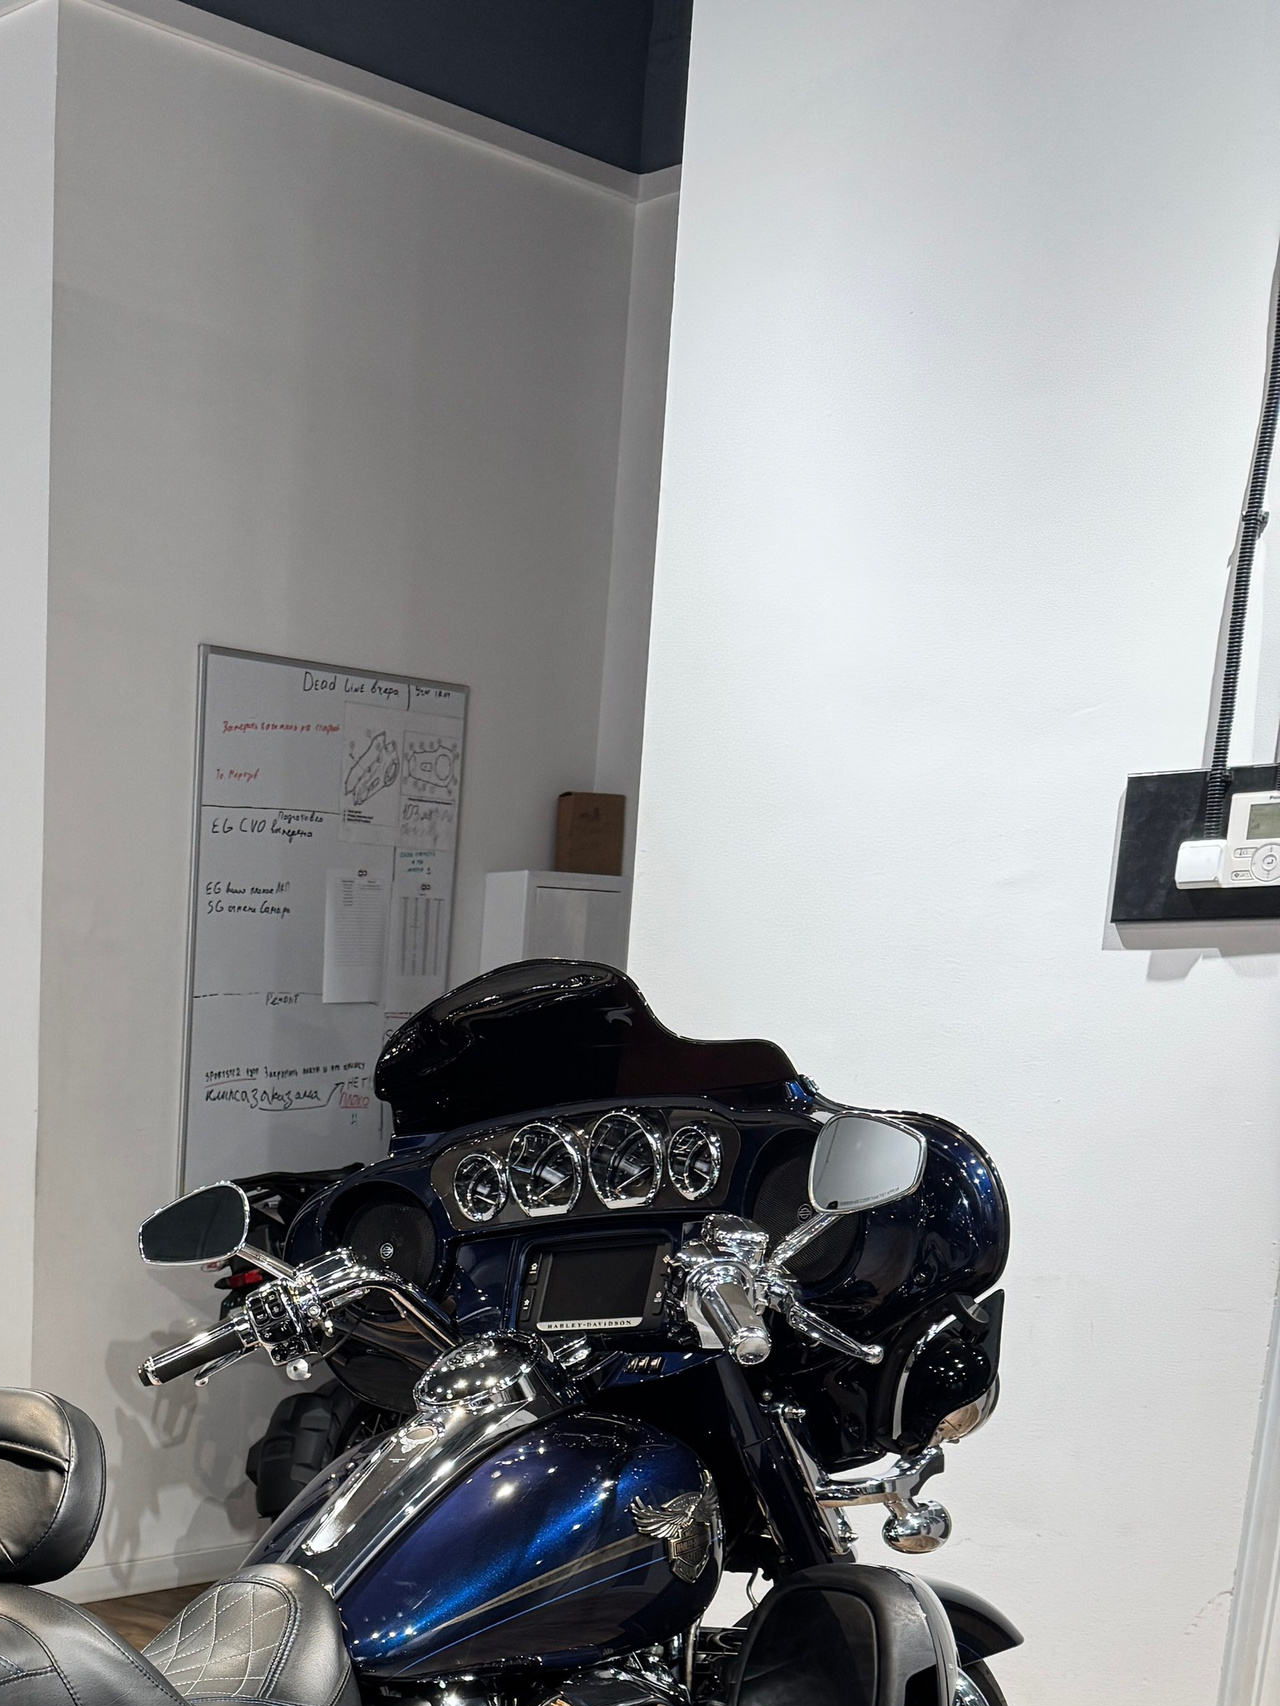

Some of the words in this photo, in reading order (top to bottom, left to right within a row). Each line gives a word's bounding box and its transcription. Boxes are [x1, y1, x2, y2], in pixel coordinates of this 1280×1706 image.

[239, 817, 266, 833] CVO
[205, 881, 221, 895] EG
[207, 900, 224, 914] SG
